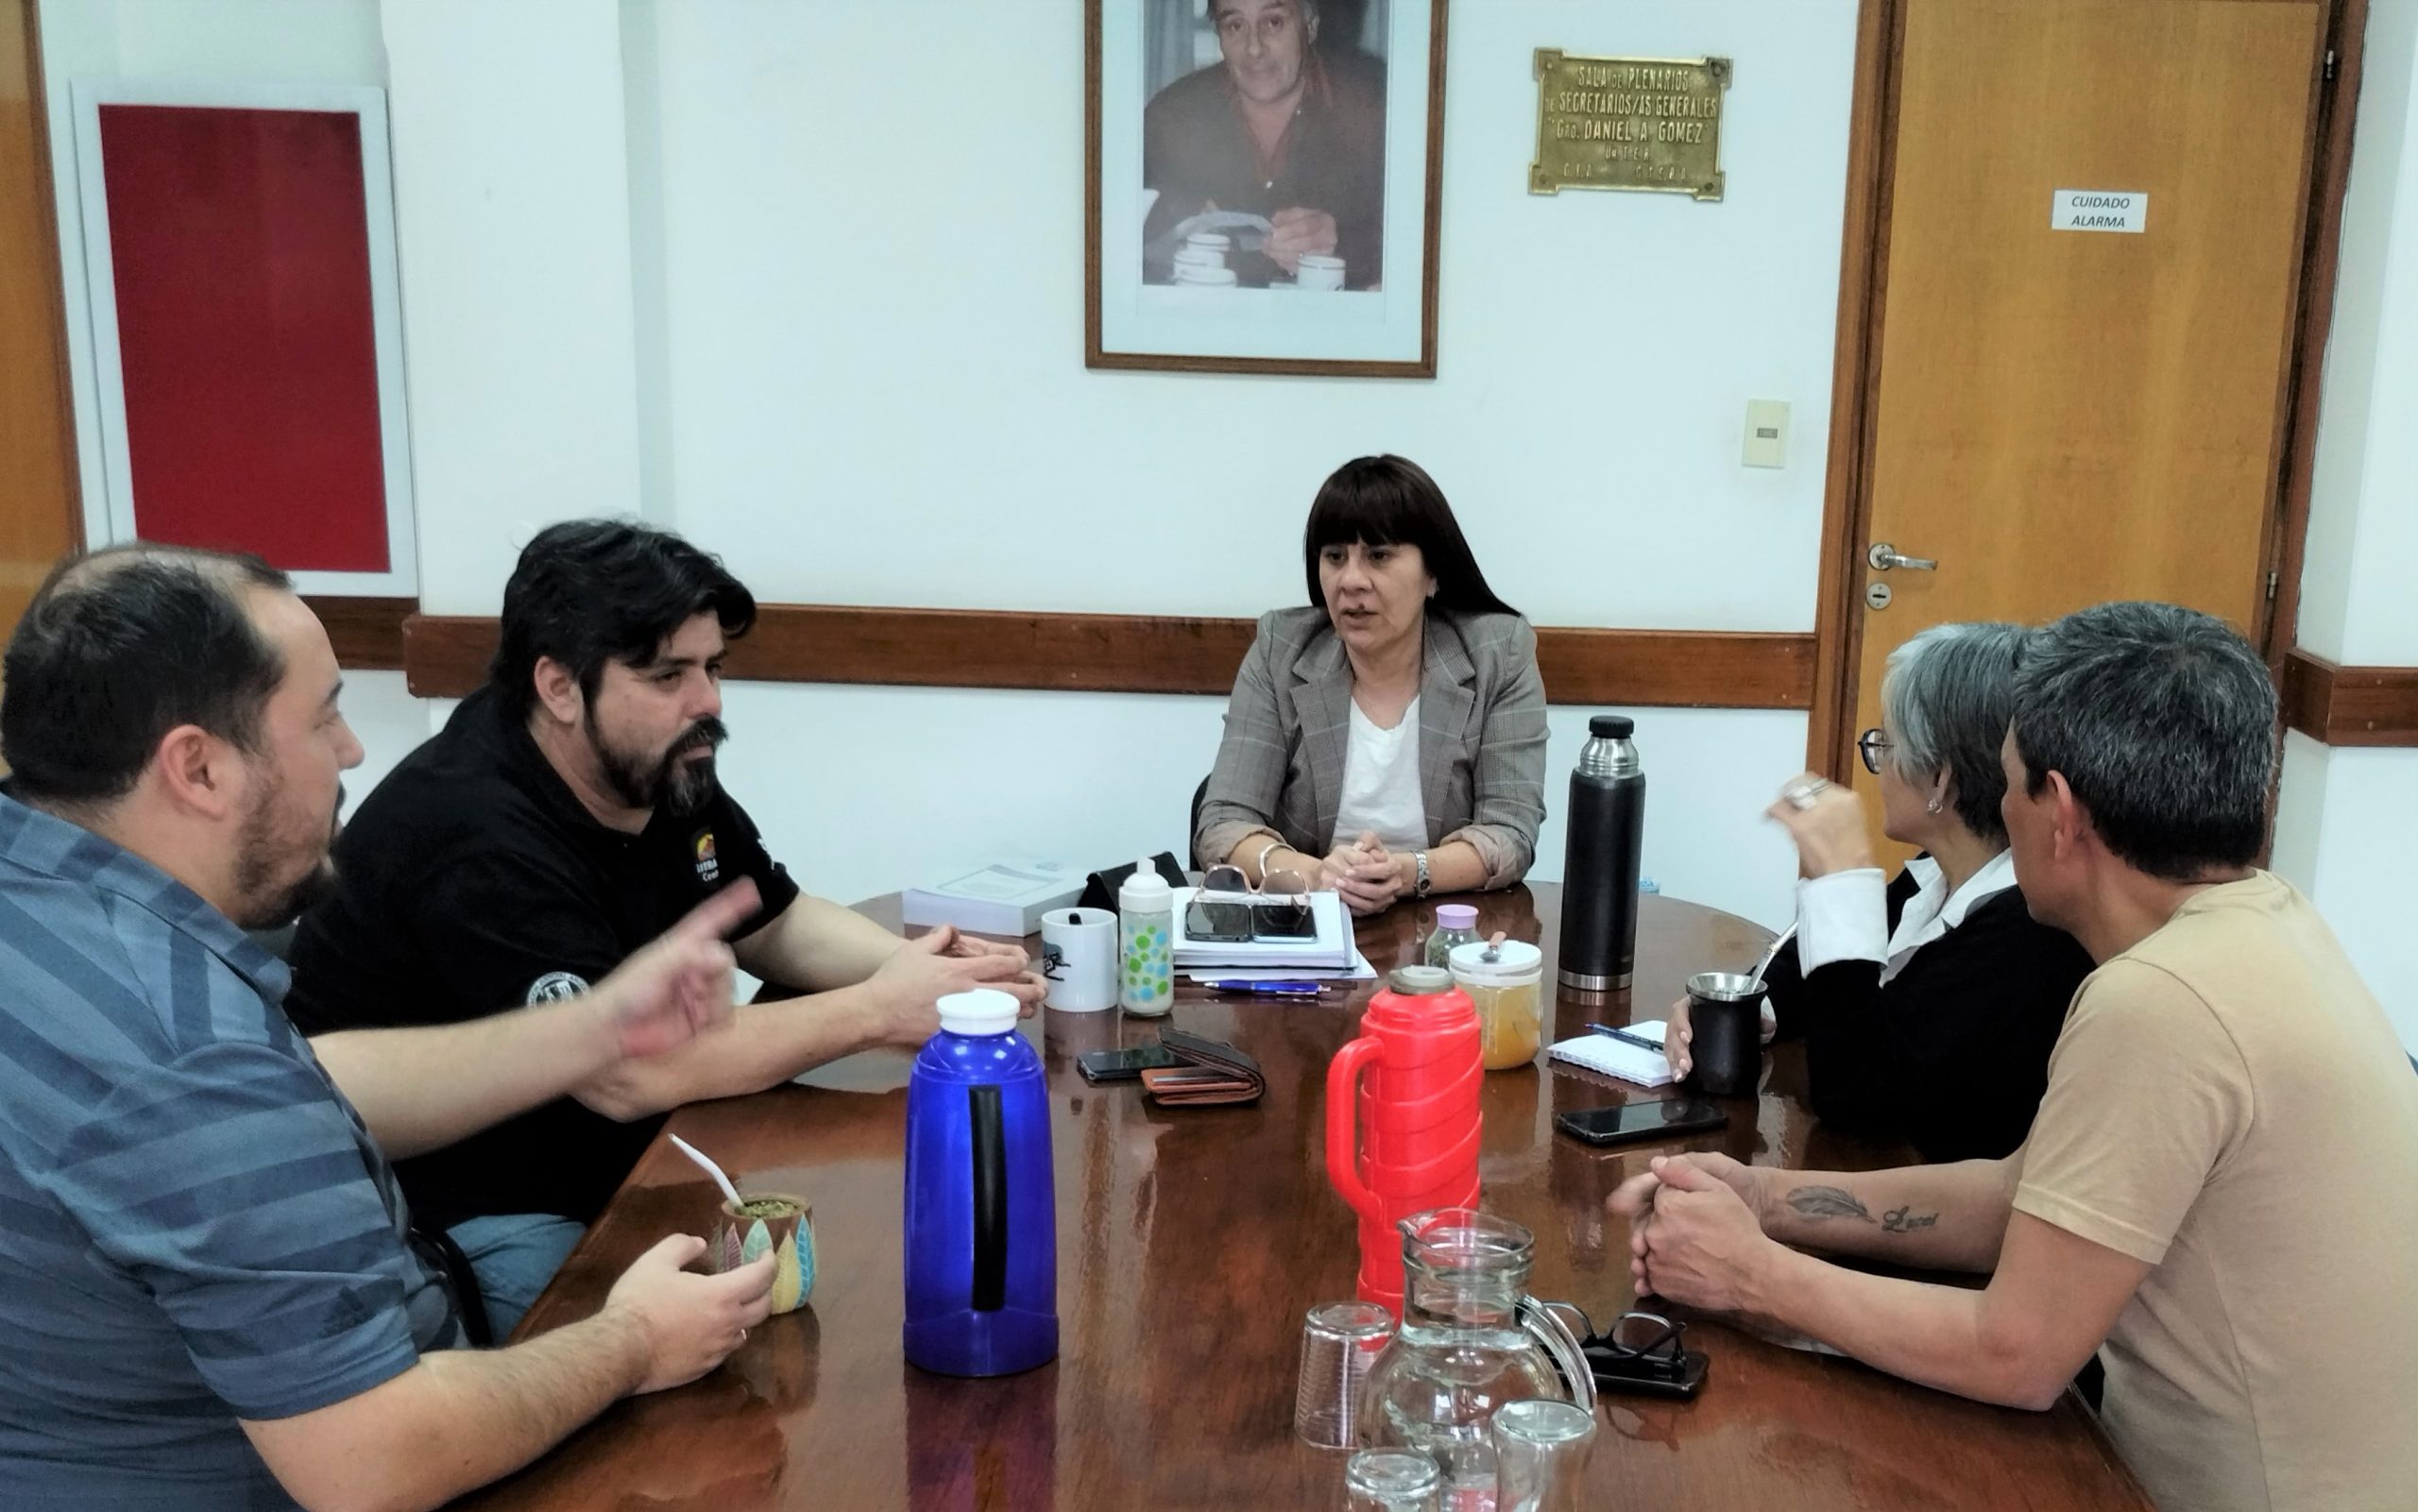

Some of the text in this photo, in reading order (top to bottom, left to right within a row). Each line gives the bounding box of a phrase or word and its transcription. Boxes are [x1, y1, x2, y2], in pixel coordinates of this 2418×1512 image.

[1578, 66, 1607, 88] SALA
[1627, 67, 1690, 92] PLENARIOS
[1559, 92, 1652, 116] SECRETARIOS/AS
[1656, 95, 1717, 118] GENERALES
[1584, 119, 1632, 141] DANIEL
[2071, 195, 2130, 209] CUIDADO
[2070, 215, 2125, 228] ALARMA
